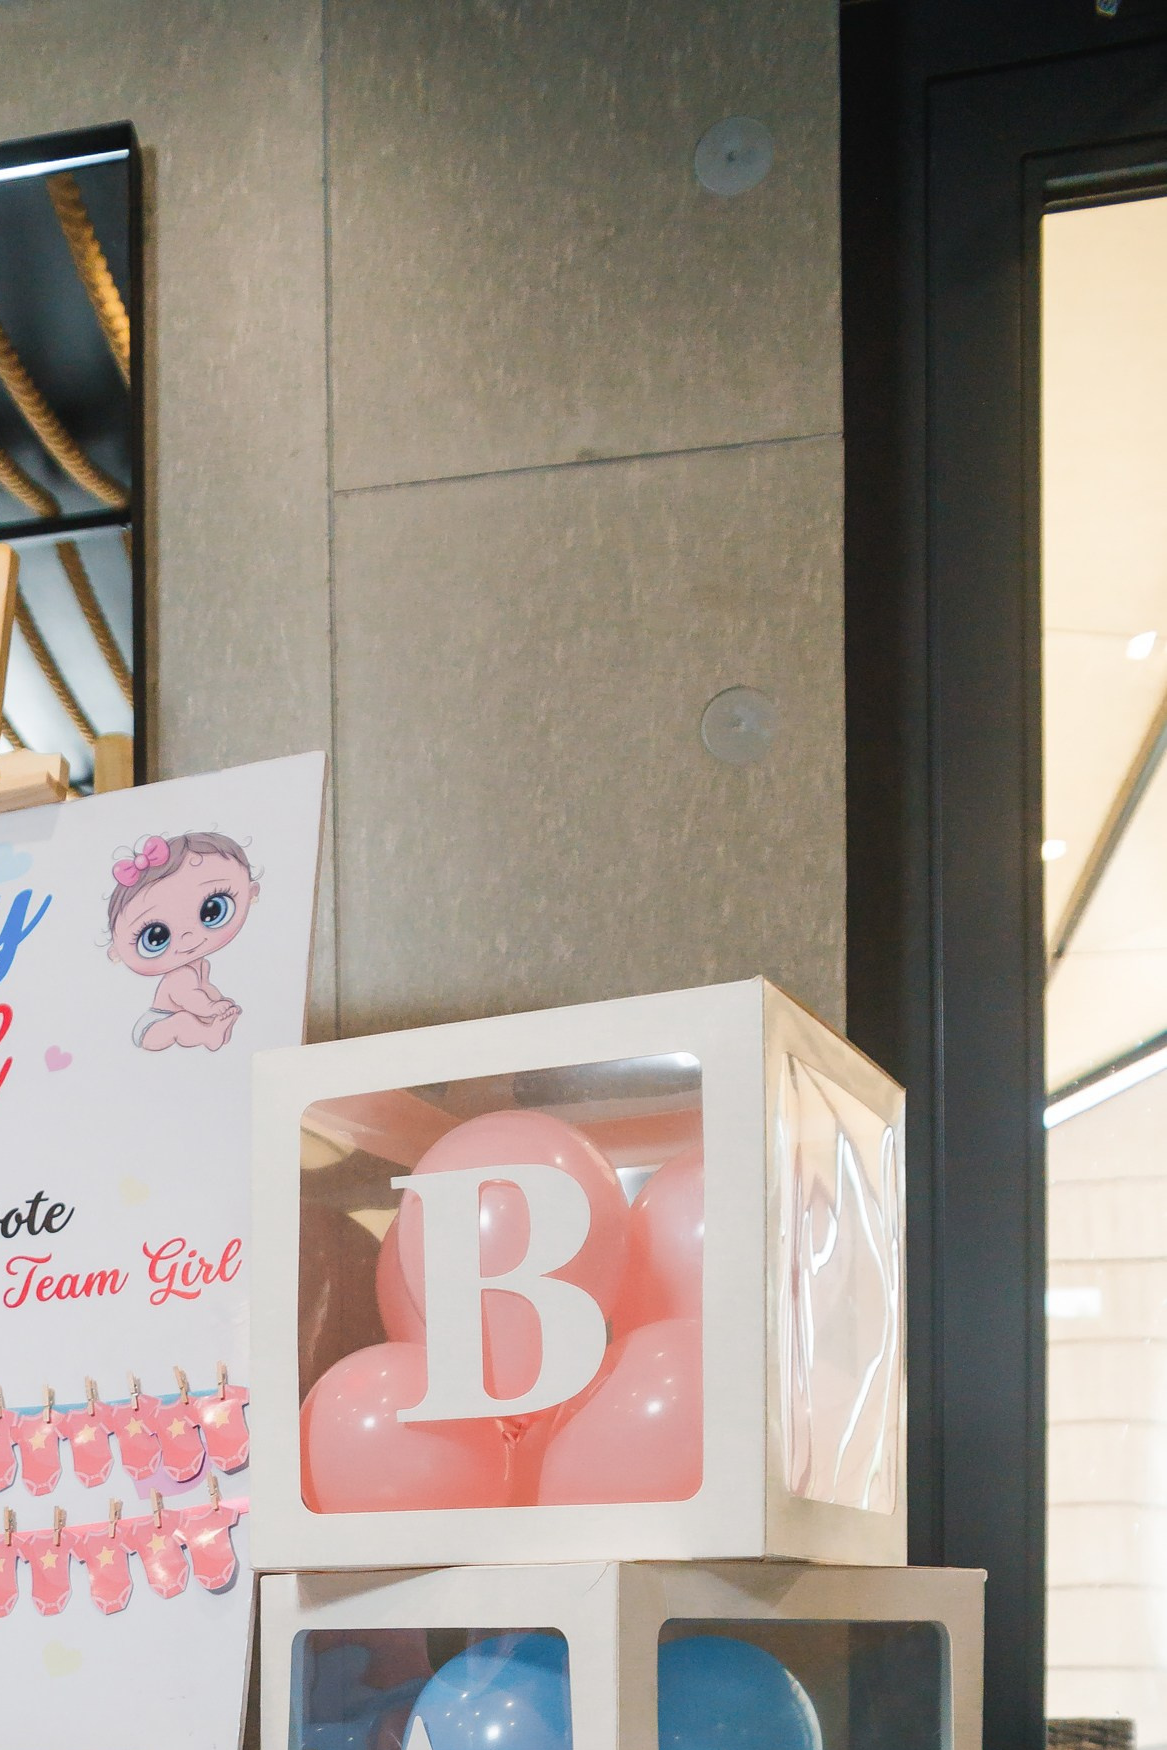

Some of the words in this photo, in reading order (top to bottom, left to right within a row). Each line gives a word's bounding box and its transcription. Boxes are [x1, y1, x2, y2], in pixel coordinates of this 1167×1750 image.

[2, 1252, 130, 1309] Team
[142, 1237, 243, 1306] Girl
[389, 1162, 608, 1424] B
